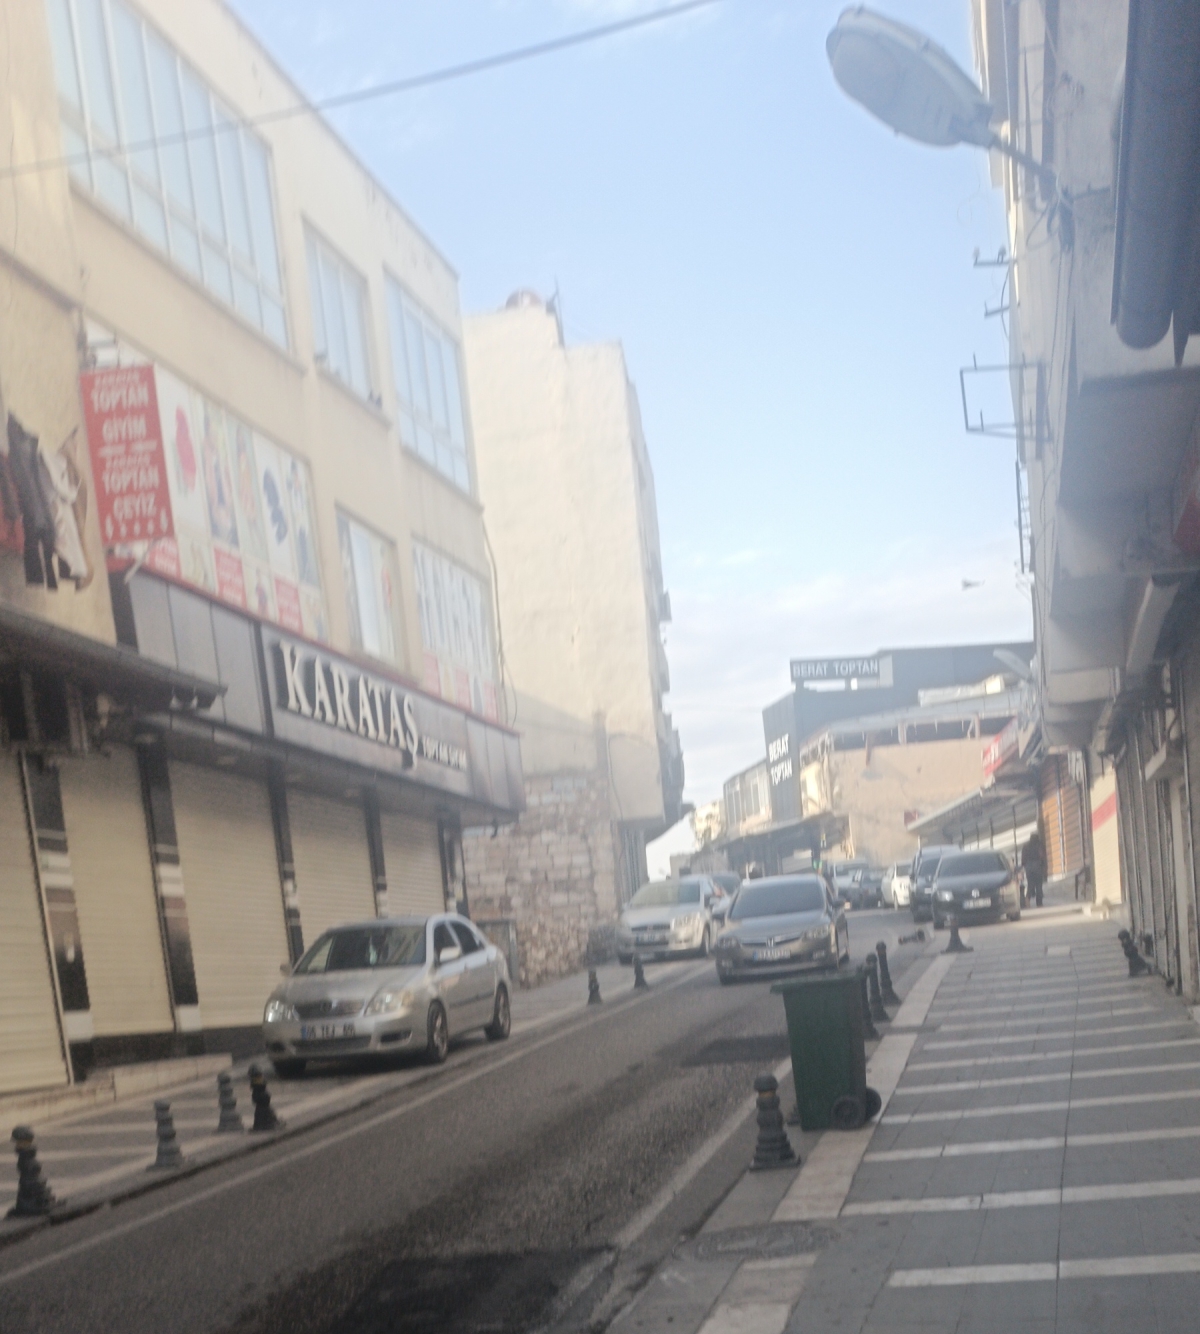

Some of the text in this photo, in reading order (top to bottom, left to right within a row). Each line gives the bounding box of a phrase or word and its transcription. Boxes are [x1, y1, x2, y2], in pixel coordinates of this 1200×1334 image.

[91, 381, 149, 413] TOPTAN
[102, 413, 148, 442] GİYİM
[102, 464, 160, 494] TOPTAN
[793, 658, 879, 678] BERAT TOPTAN
[279, 639, 419, 771] KARATAŞ
[768, 732, 789, 764] BERAT
[770, 757, 793, 786] TOPTAN
